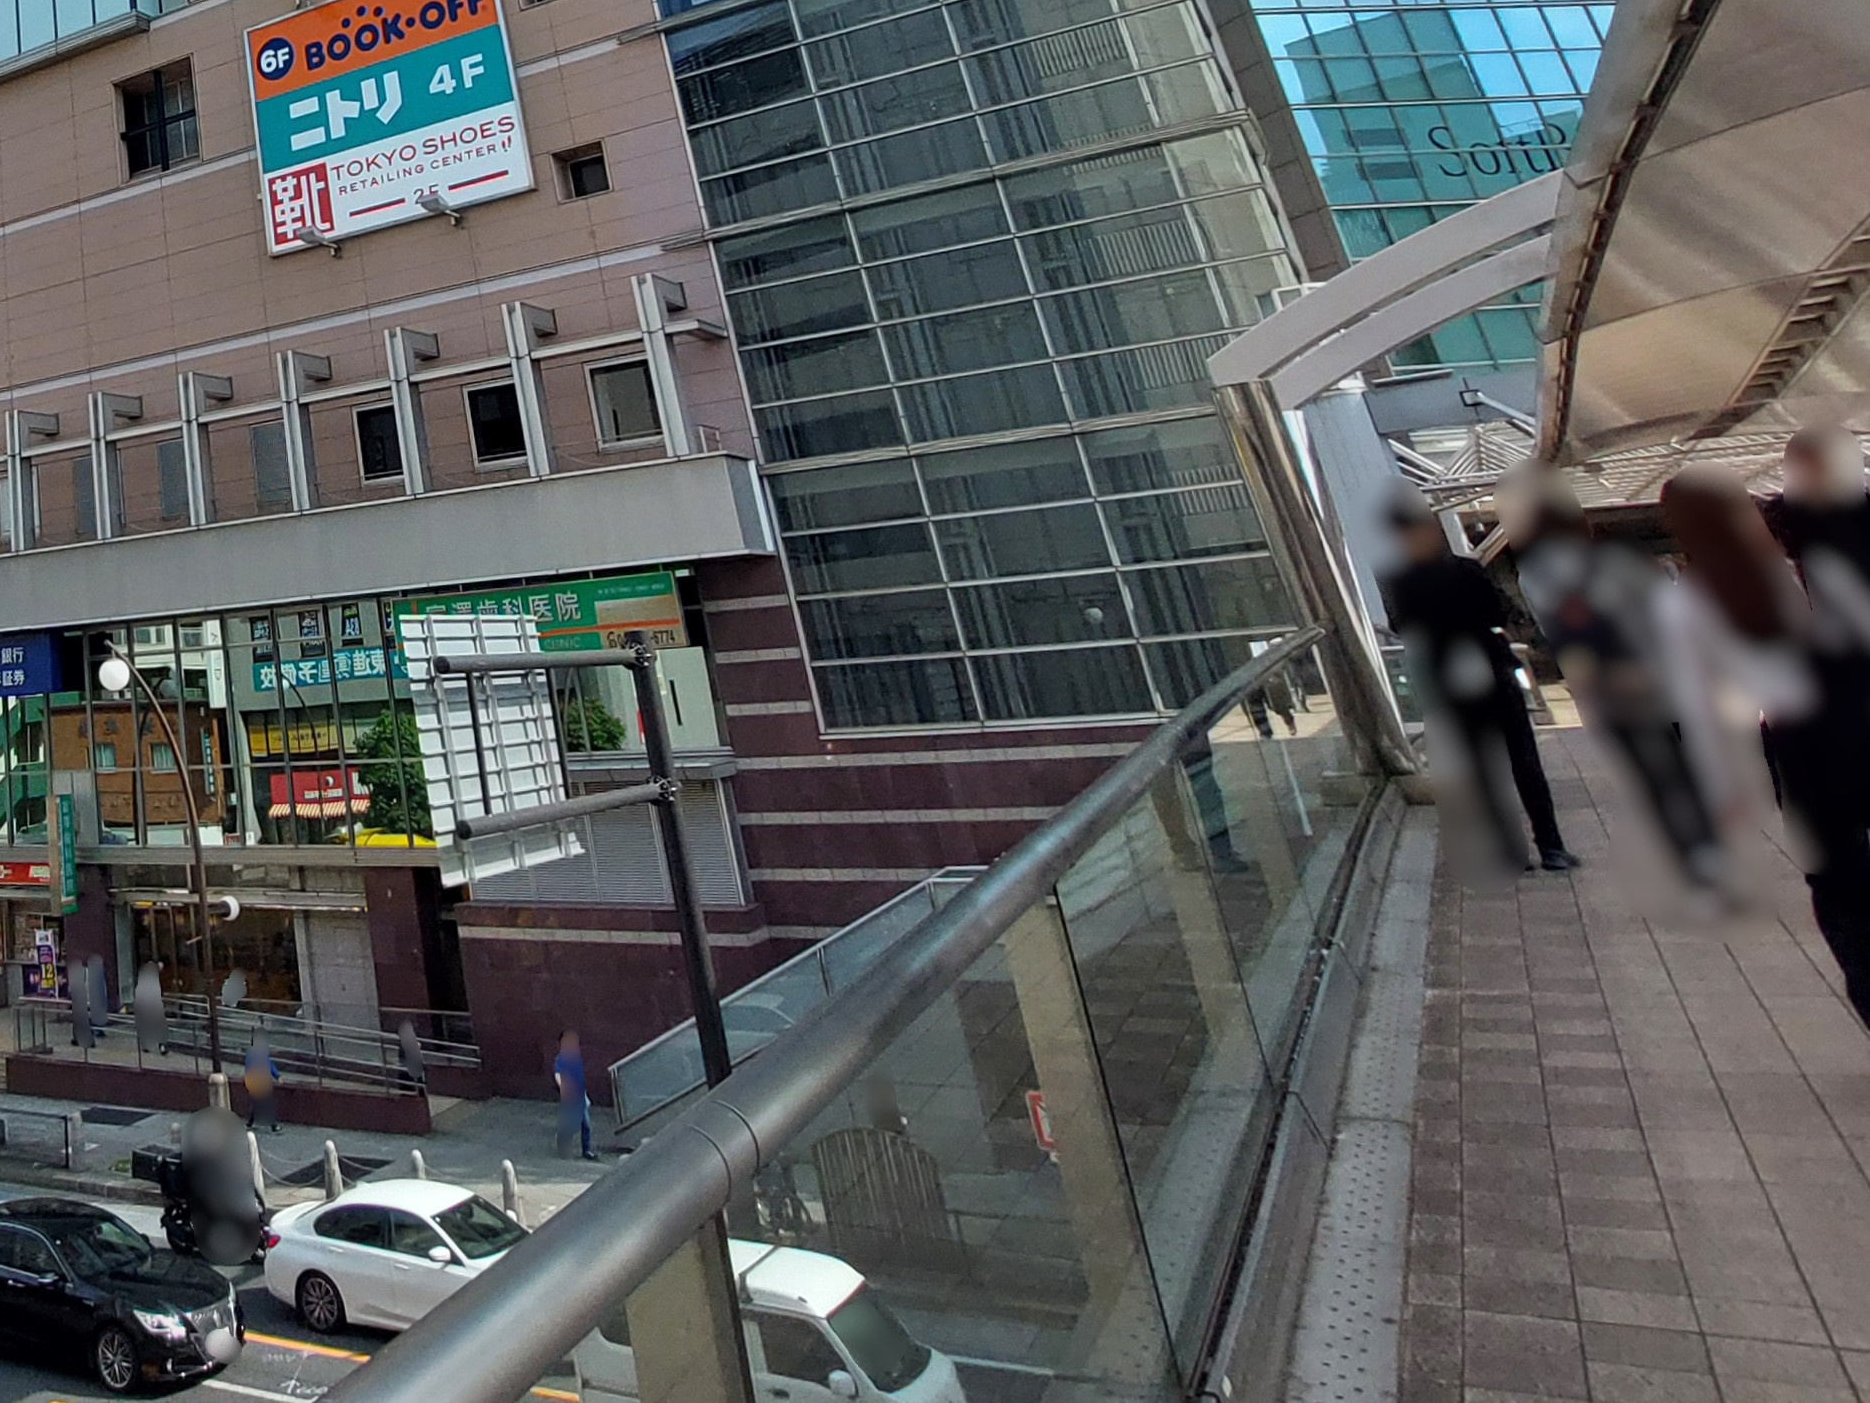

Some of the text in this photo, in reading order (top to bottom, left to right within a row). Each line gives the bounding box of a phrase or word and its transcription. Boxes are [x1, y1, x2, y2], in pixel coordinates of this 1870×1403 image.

[260, 44, 291, 73] 6F
[288, 53, 486, 152] ニトリ 4F
[330, 115, 516, 181] TOKYO SHOES
[338, 143, 498, 196] RETAILING CENTER
[272, 172, 331, 240] 靴
